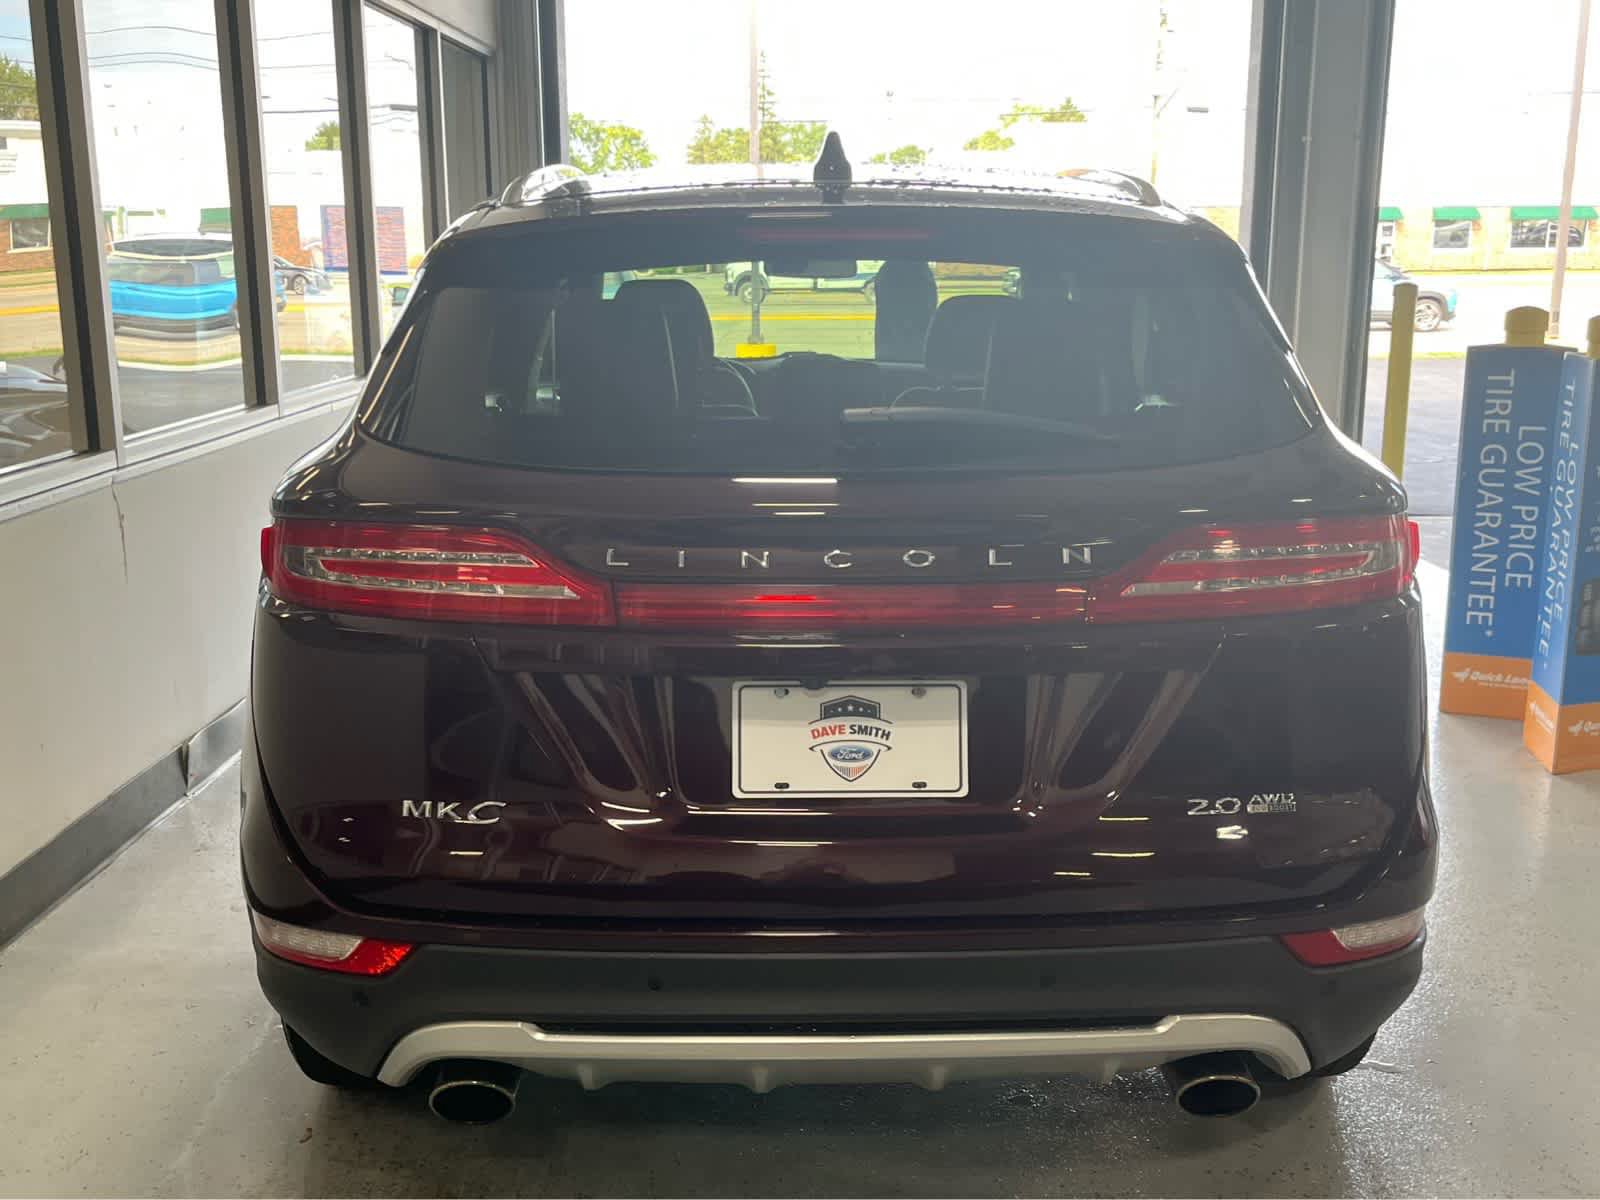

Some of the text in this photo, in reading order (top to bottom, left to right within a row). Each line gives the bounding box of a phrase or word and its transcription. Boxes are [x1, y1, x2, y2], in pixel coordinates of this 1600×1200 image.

[1482, 368, 1516, 434] TIRE
[1560, 376, 1576, 449] TIRE
[1504, 426, 1547, 589] LOW PRICE
[606, 546, 1092, 569] LINCOLN
[810, 724, 891, 741] DAVE SMITH
[836, 746, 866, 760] Ford
[402, 799, 506, 825] MKC
[1187, 797, 1242, 816] 2.0
